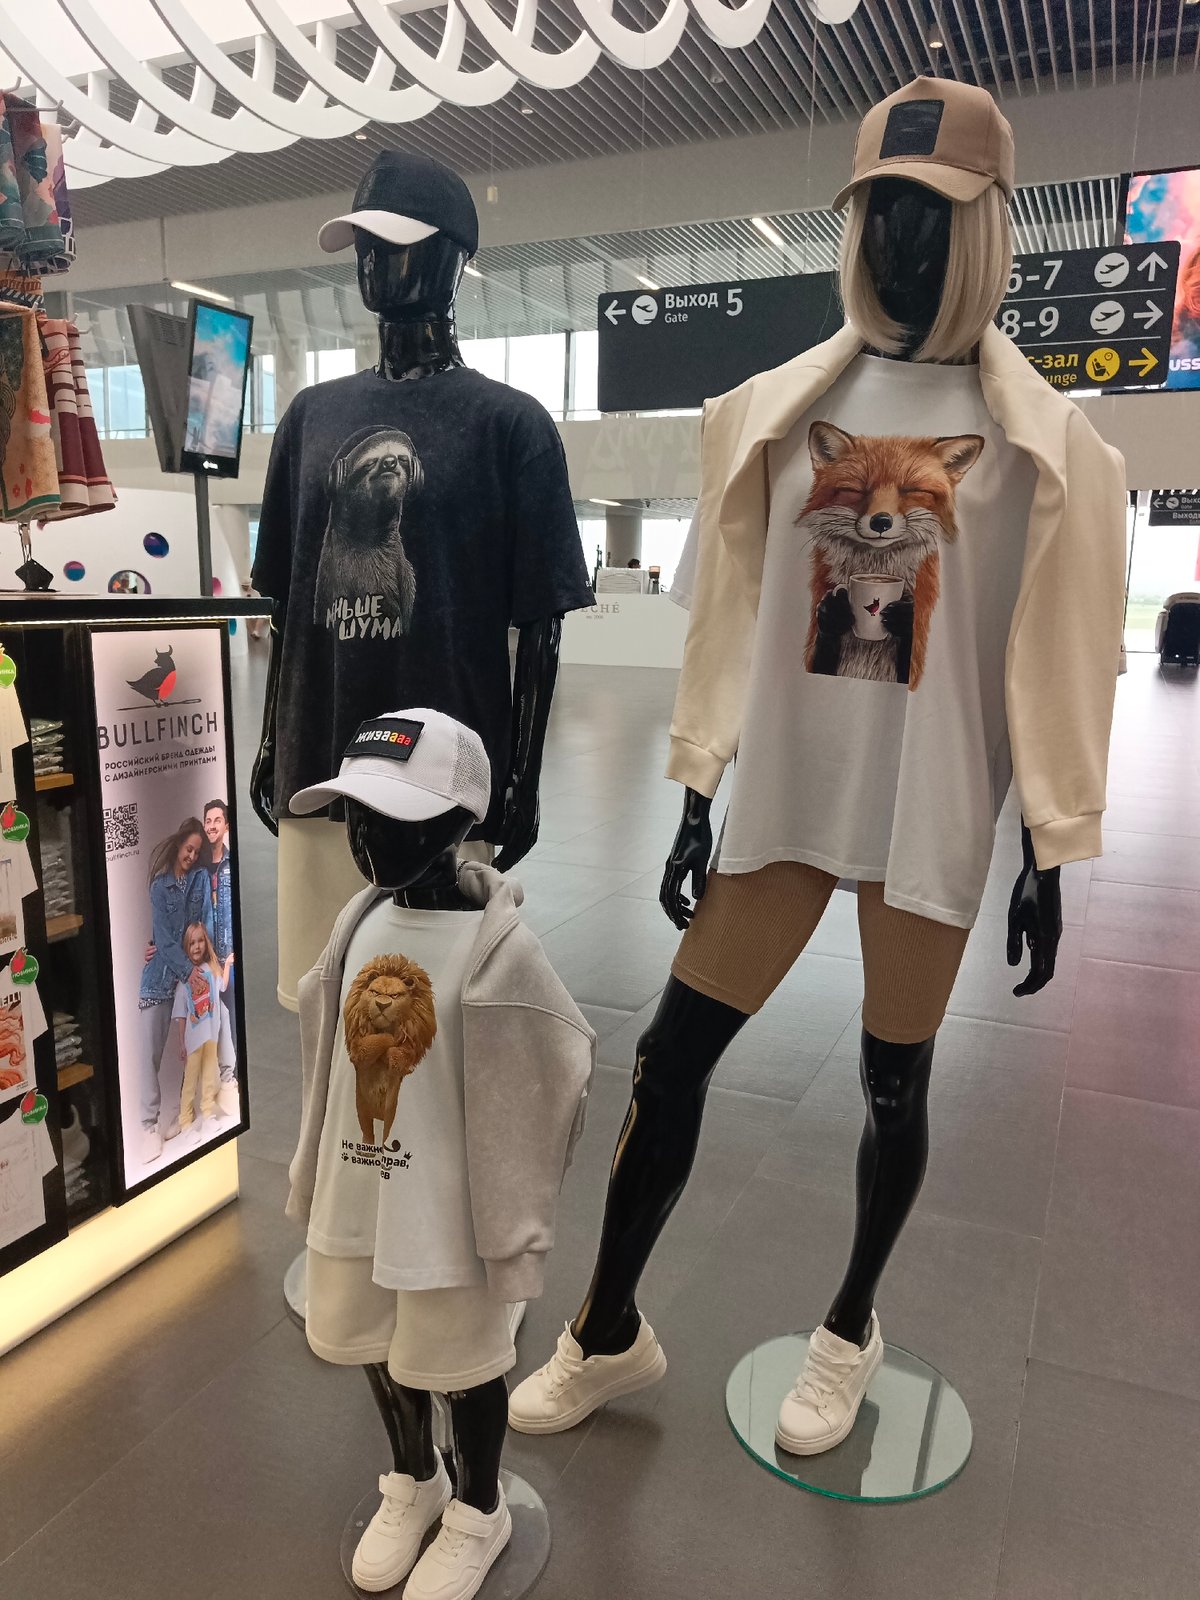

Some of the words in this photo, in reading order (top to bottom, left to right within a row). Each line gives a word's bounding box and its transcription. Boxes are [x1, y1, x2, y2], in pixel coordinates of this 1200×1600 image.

[665, 292, 719, 309] Выход
[726, 288, 743, 316] 5
[664, 312, 689, 324] Gate
[999, 306, 1060, 339] 8-9
[1045, 373, 1078, 386] unge
[339, 616, 403, 640] ШУМА
[97, 711, 218, 750] BULLFINCH
[104, 752, 160, 771] РОССИЙСКИЙ
[161, 750, 184, 761] БРЕНД
[184, 745, 216, 756] ОДЕЖДЫ
[112, 763, 178, 782] ДИЗАЙНЕРСКИМИ
[179, 755, 217, 769] ПРИНТАМИ
[341, 1139, 354, 1150] Не
